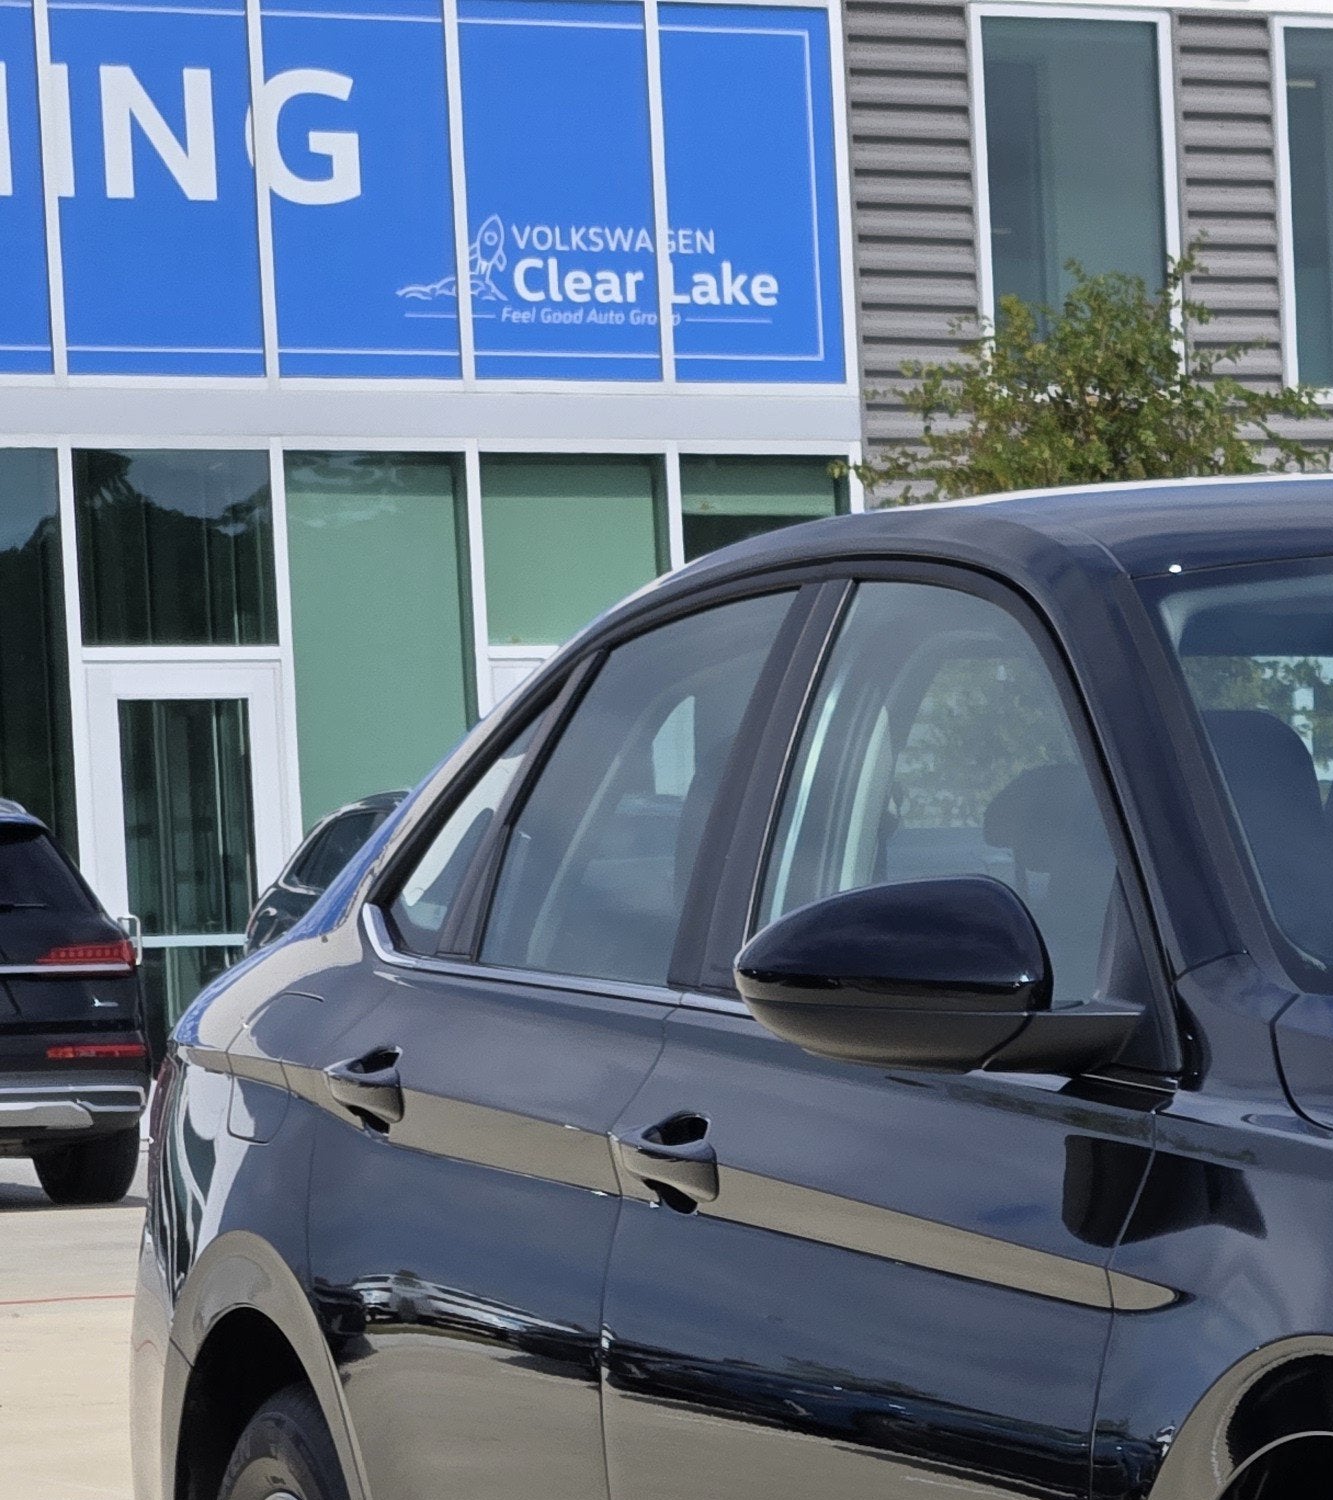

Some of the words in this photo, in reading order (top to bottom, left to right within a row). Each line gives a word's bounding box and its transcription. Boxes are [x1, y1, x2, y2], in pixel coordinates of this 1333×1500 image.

[0, 61, 361, 205] ING
[513, 256, 644, 303] Clear
[669, 260, 779, 306] Lake
[501, 306, 536, 324] Feel
[540, 307, 583, 325] Good
[586, 307, 625, 325] Auto
[629, 308, 681, 327] Grop
